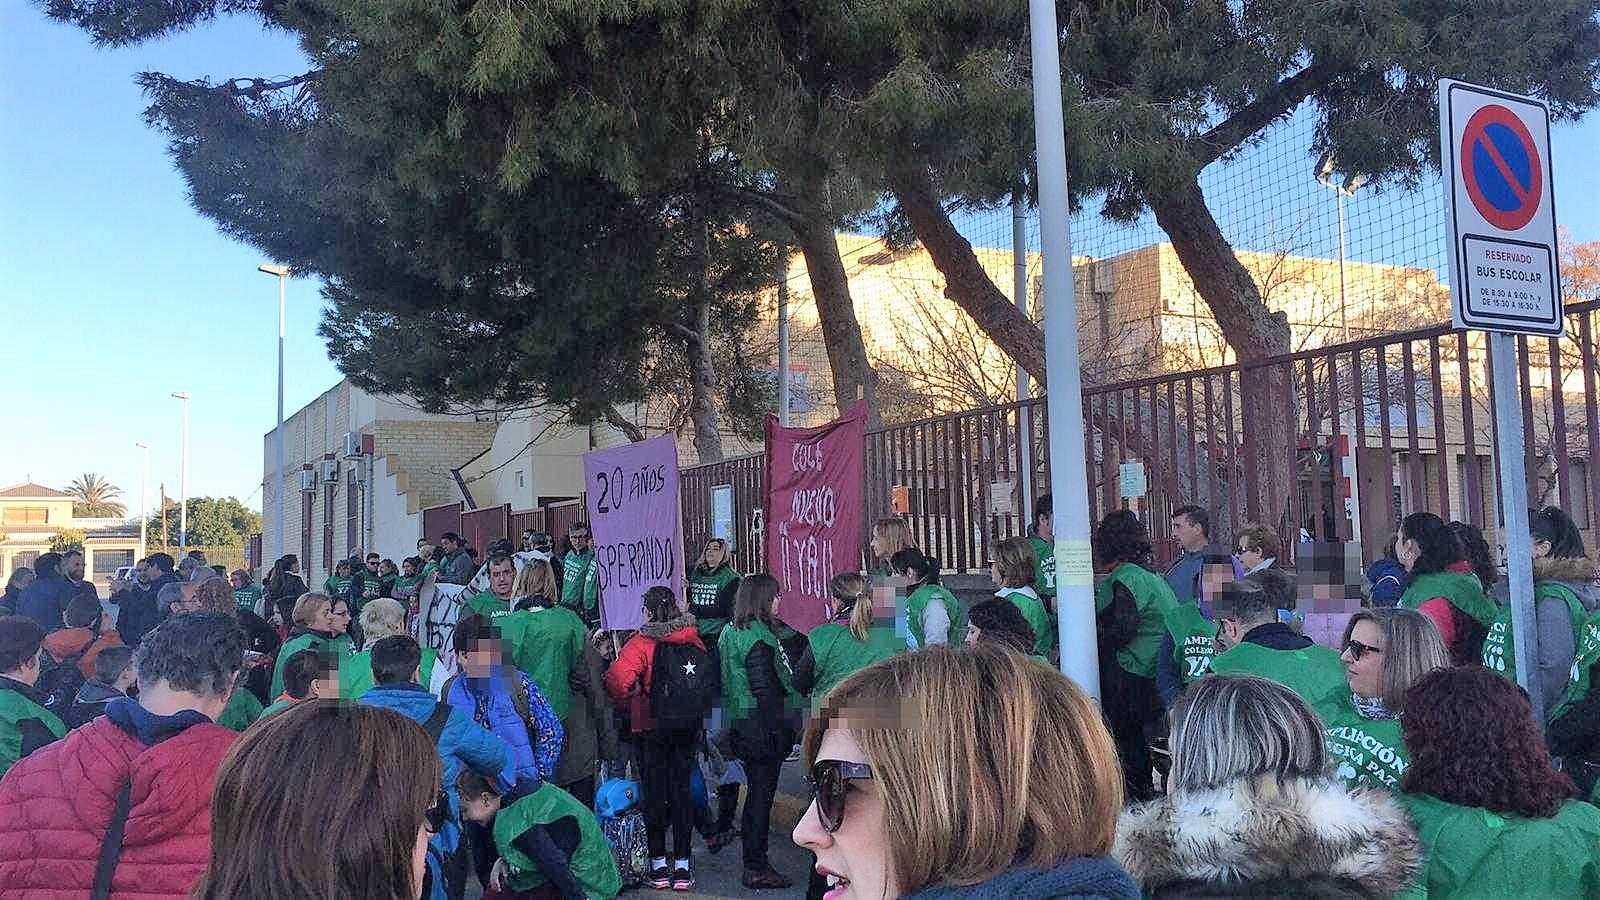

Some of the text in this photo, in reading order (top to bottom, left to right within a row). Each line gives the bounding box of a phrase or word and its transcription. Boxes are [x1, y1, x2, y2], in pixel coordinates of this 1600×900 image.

[1485, 250, 1532, 264] RESERVADO
[1477, 266, 1542, 283] BUS ESCOLAR
[597, 465, 665, 513] 20 AÑOS
[595, 536, 674, 591] SPERANDO
